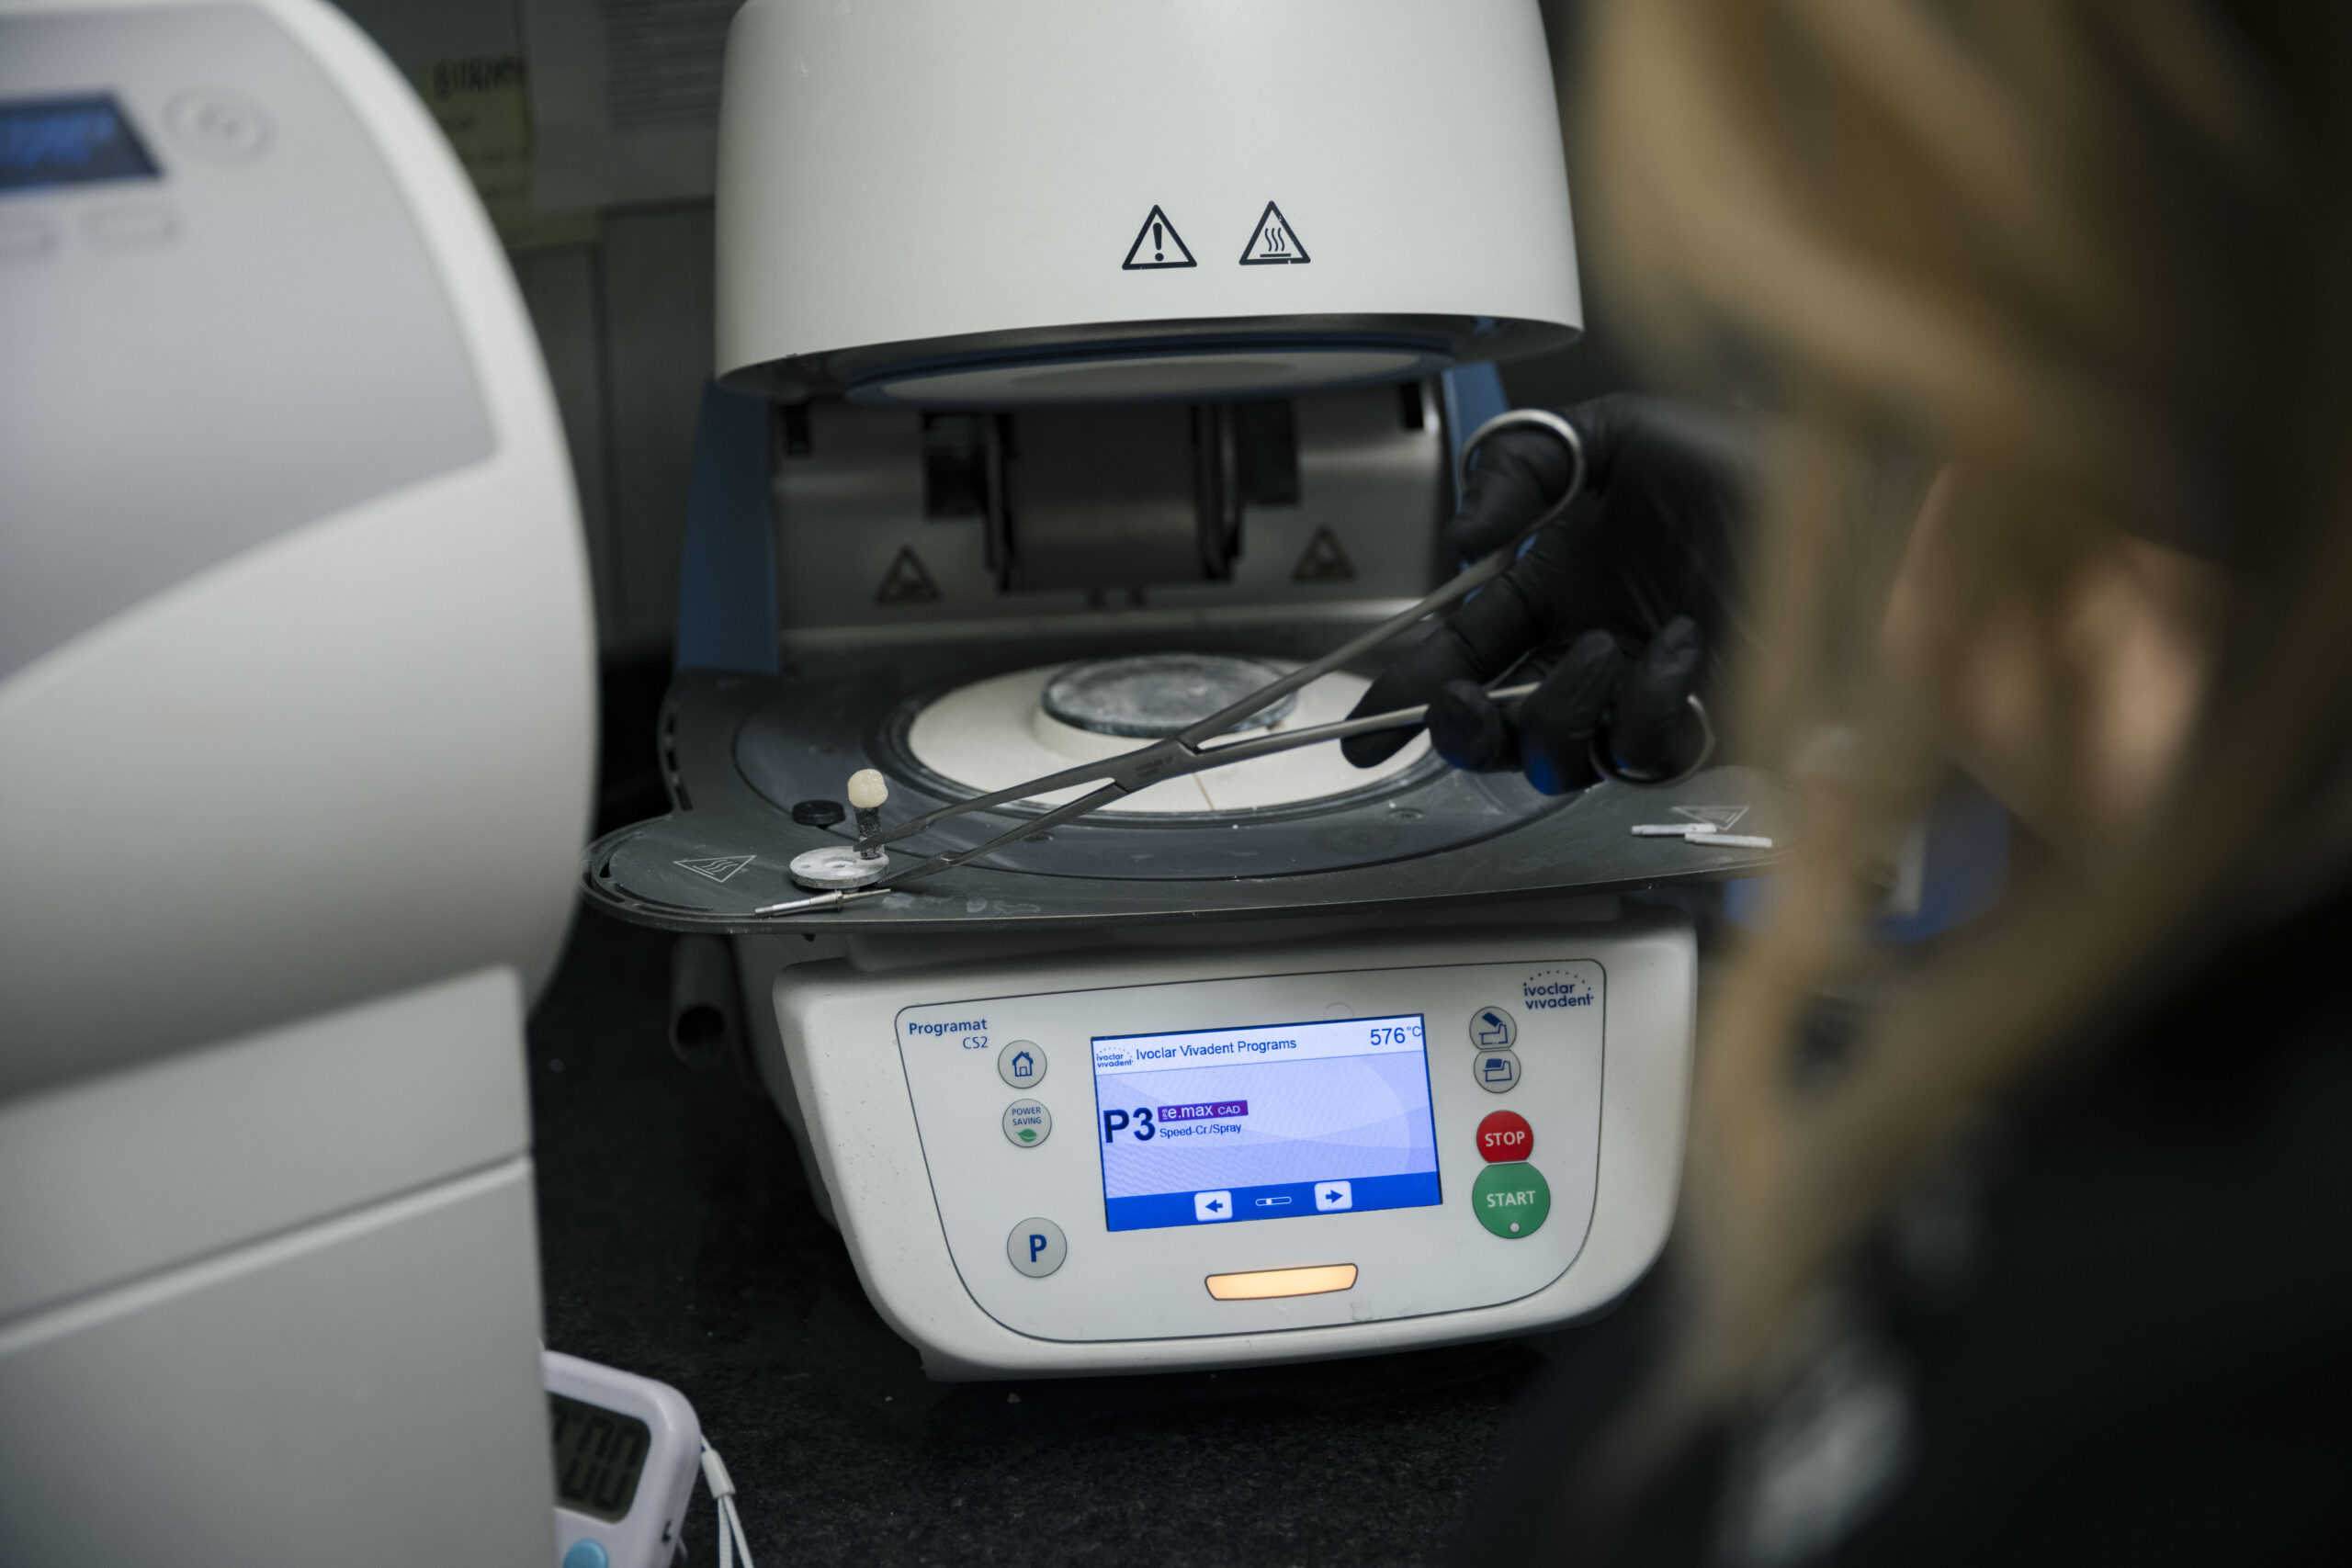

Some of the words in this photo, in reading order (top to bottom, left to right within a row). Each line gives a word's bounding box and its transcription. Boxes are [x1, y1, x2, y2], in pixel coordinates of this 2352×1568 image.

[1522, 982, 1575, 997] ivoclar
[1525, 993, 1591, 1010] vivadent
[909, 1018, 988, 1036] Programat
[962, 1036, 989, 1049] CS2
[1136, 1046, 1177, 1060] Ivoclar
[1180, 1041, 1234, 1056] Vivadent
[1238, 1038, 1297, 1055] Programs
[1097, 1059, 1132, 1067] vivadent
[1012, 1106, 1041, 1116] POWER
[1168, 1105, 1214, 1119] e.max
[1217, 1105, 1240, 1115] CAD
[1012, 1116, 1042, 1126] SAVING
[1102, 1107, 1156, 1144] P3
[1485, 1131, 1525, 1147] STOP
[1487, 1190, 1536, 1208] START
[1029, 1234, 1047, 1262] P
